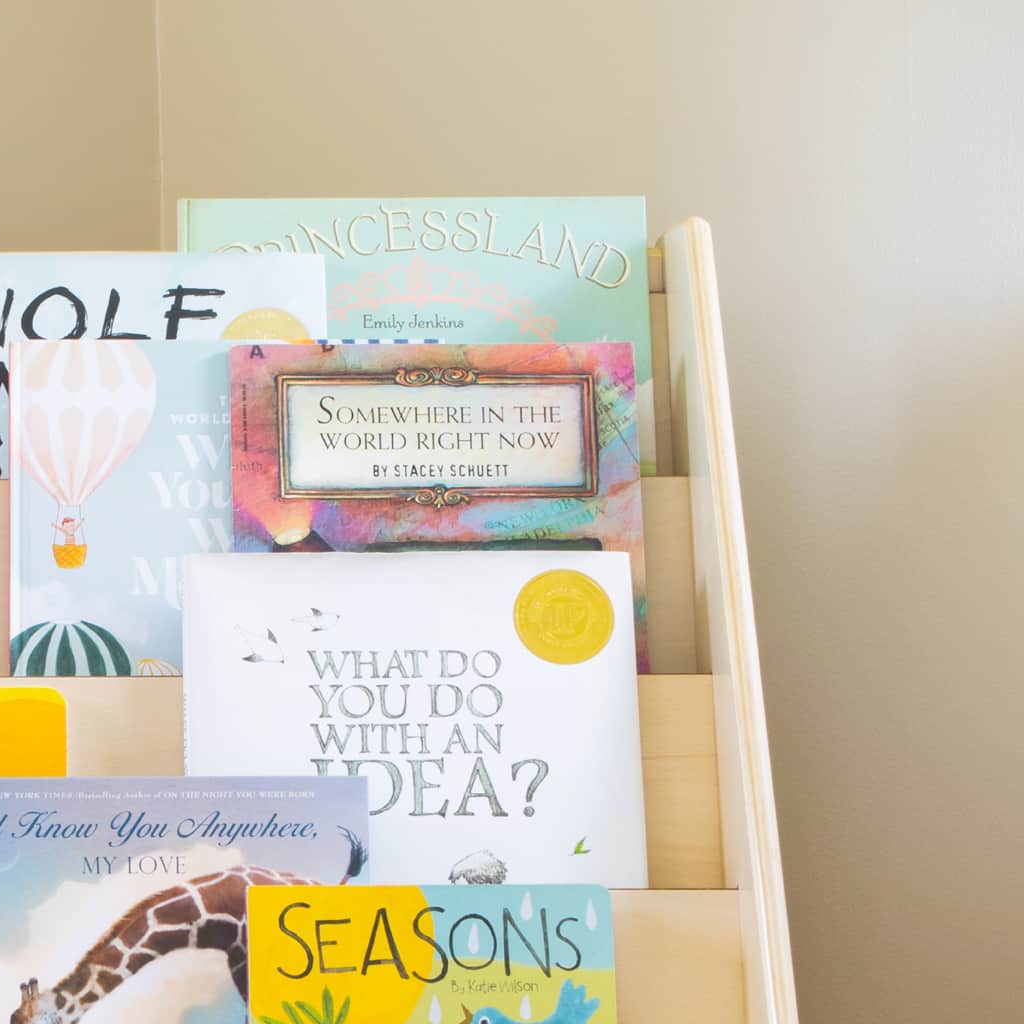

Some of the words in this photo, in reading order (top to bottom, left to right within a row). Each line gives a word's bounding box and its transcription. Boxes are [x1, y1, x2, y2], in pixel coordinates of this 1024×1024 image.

[214, 203, 632, 289] INCESSLAND
[363, 314, 405, 333] Emily
[407, 314, 465, 330] Jenkins
[170, 413, 232, 425] WORLD
[316, 394, 472, 425] SOMEWHERE
[481, 406, 504, 424] IN
[513, 405, 562, 424] THE
[319, 431, 407, 450] WORLD
[416, 431, 490, 450] RIGHT
[499, 431, 560, 450] NOW
[372, 464, 388, 478] BY
[394, 464, 444, 478] STACEY
[450, 463, 510, 478] SCHUETT
[307, 649, 429, 680] WHAT
[439, 649, 502, 679] DO
[308, 683, 411, 719] YOU
[427, 683, 504, 718] DO
[309, 722, 431, 755] WITH
[442, 722, 505, 755] AN
[14, 791, 41, 800] YORK
[181, 791, 201, 800] THE
[202, 791, 231, 800] NIGHT
[236, 791, 256, 800] YOU
[309, 756, 550, 818] DEA?
[11, 810, 99, 840] Know
[110, 809, 168, 848] You
[176, 809, 319, 848] Anywhere,
[82, 855, 118, 876] MY
[127, 855, 188, 875] LOVE
[276, 902, 582, 984] SEASONS
[450, 980, 465, 995] By
[468, 979, 497, 994] Katie
[499, 979, 540, 993] Wilson
